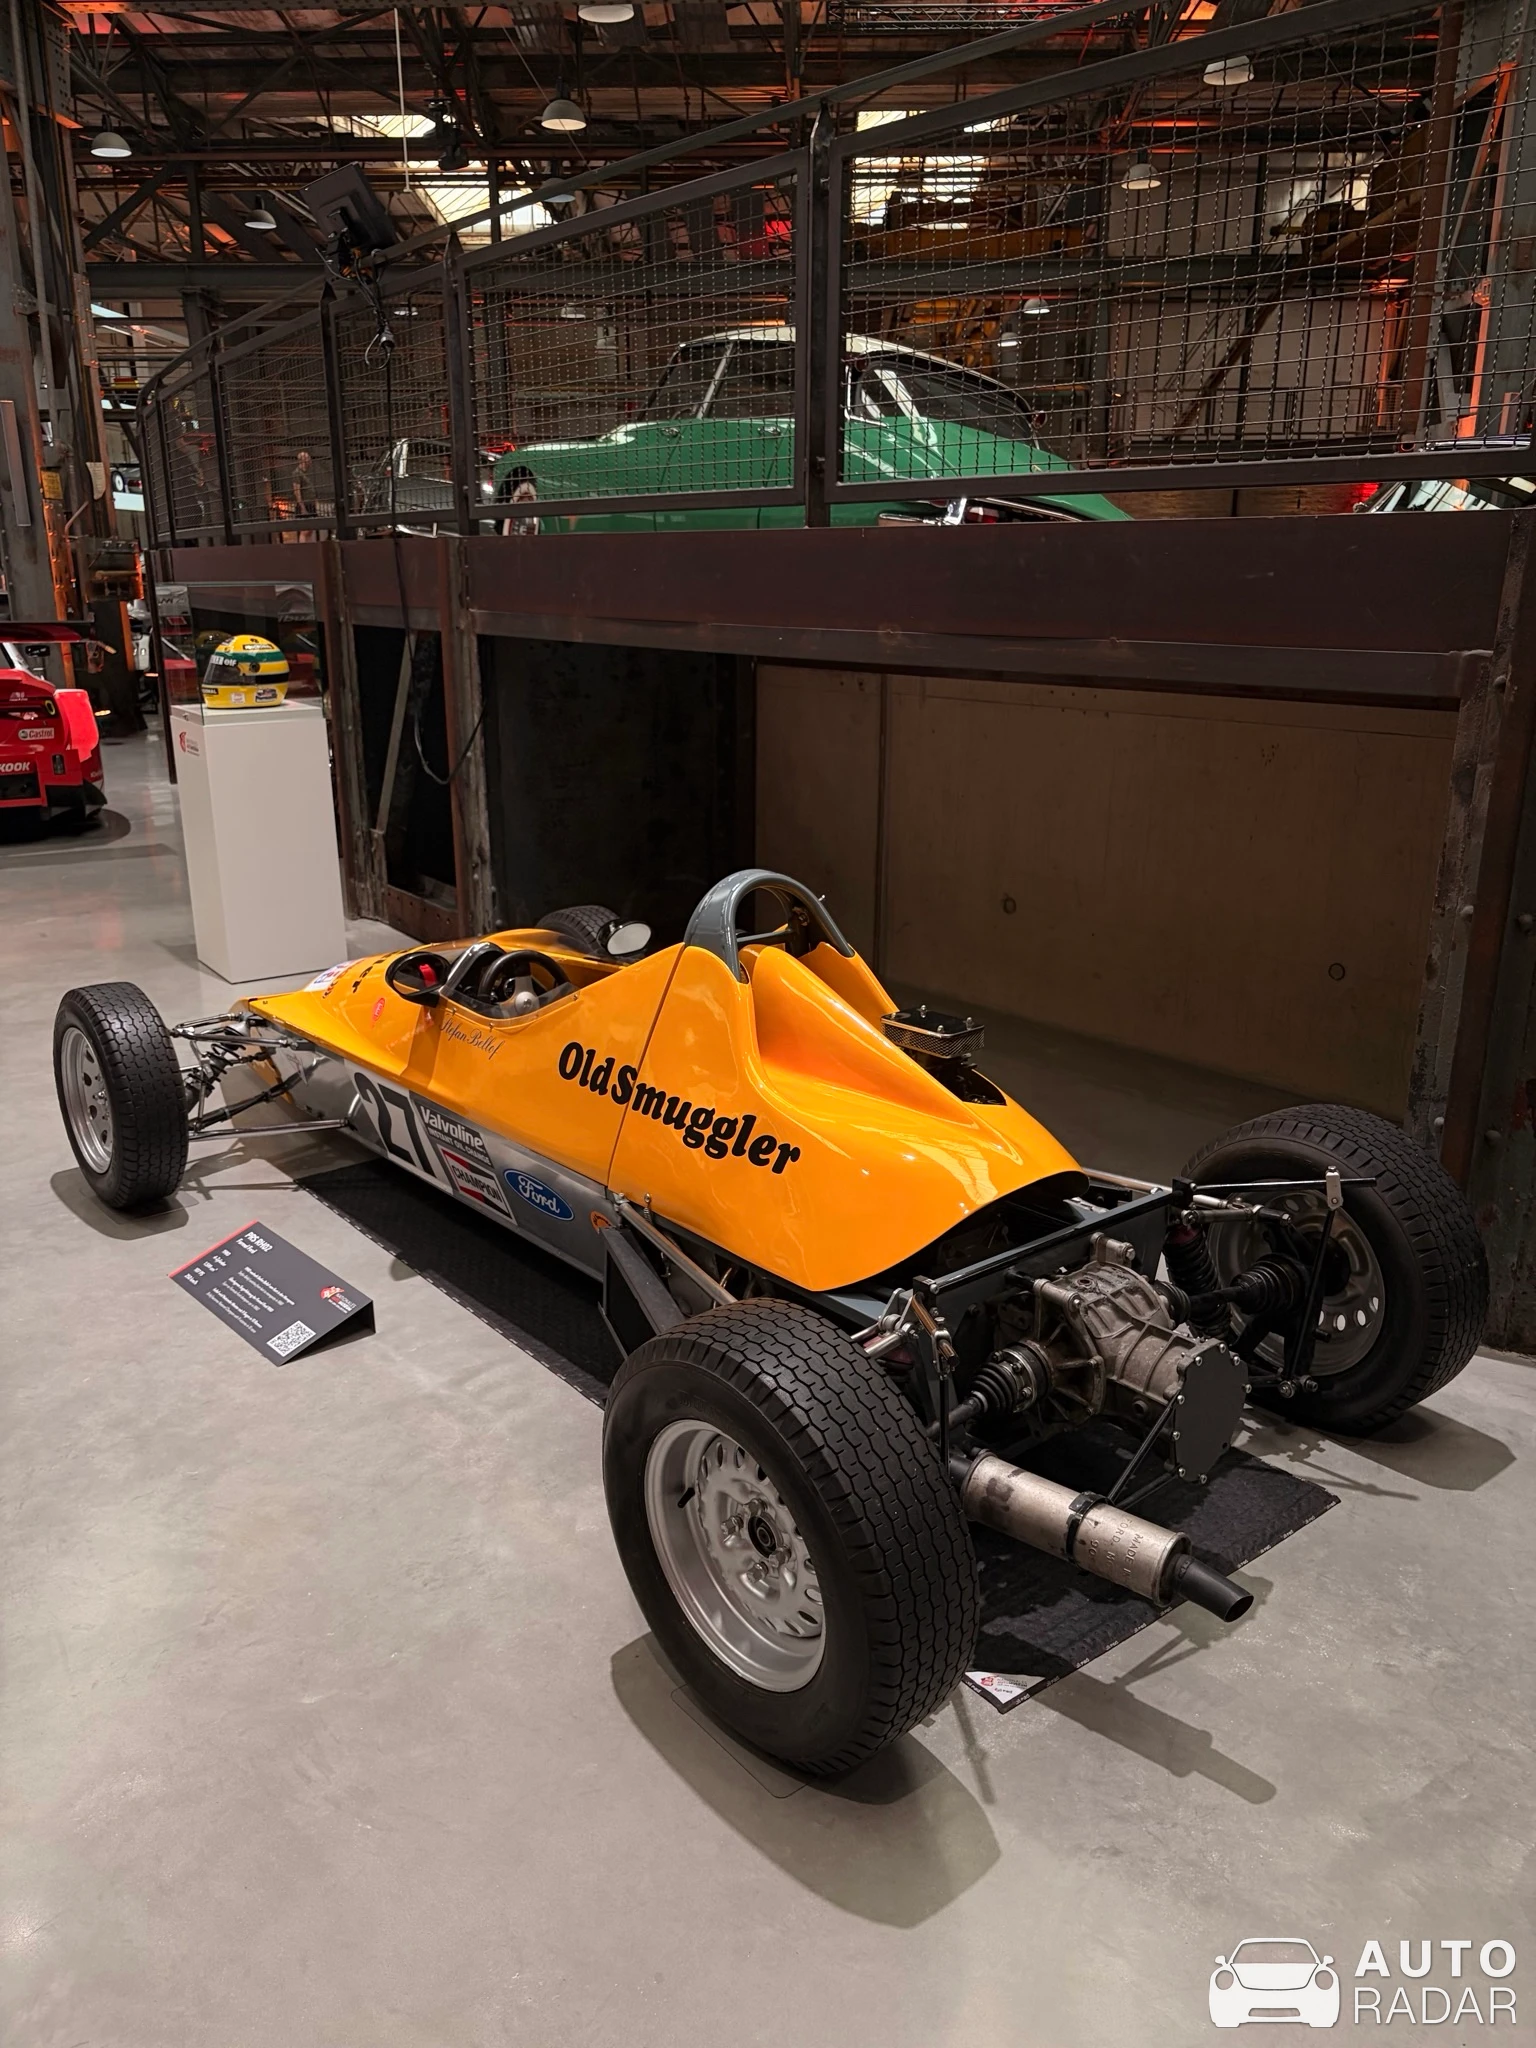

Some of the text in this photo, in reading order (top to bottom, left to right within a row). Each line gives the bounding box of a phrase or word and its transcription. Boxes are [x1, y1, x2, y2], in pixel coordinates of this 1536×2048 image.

[28, 730, 53, 739] Castrol
[440, 1017, 505, 1060] Stefan Bellof
[354, 1072, 437, 1178] 27
[558, 1041, 801, 1174] Old Smuggler
[421, 1105, 486, 1154] Valvoline
[454, 1140, 465, 1151] OIL
[452, 1166, 503, 1203] CHAMPION
[518, 1176, 560, 1213] Ford
[1125, 1533, 1143, 1565] MADE
